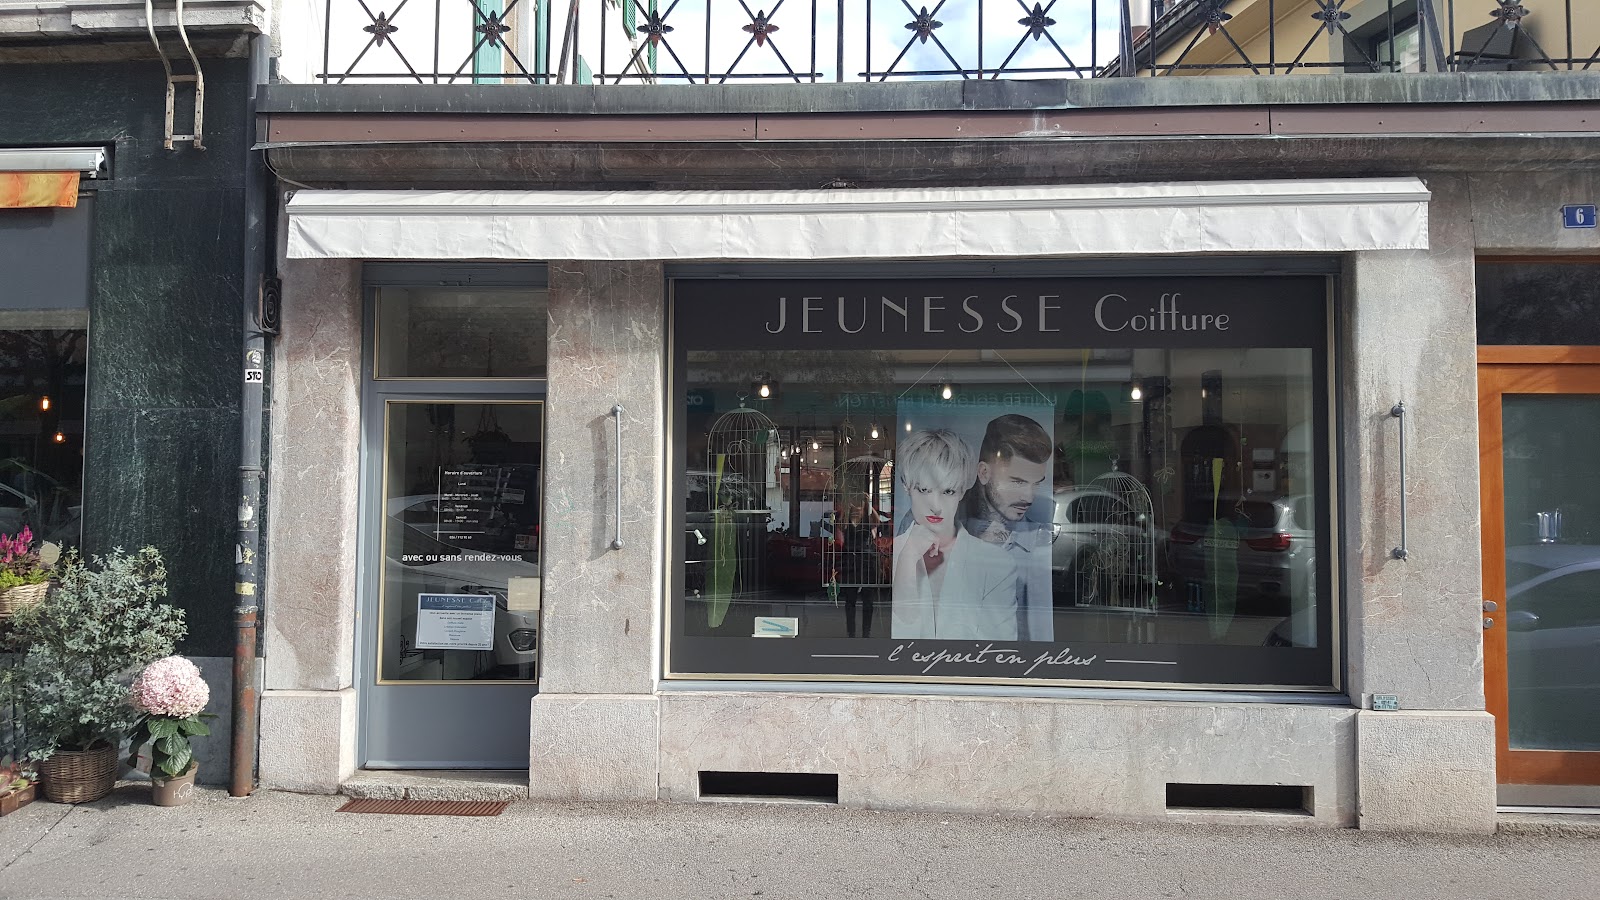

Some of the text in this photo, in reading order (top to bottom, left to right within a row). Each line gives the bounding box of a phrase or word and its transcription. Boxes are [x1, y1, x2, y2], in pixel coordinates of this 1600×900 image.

[1575, 207, 1585, 225] 6
[765, 292, 1231, 334] JEUNESSE Coiffure
[401, 552, 523, 562] avec ou sans rendez-vous
[887, 641, 1098, 676] l'esprit en plus
